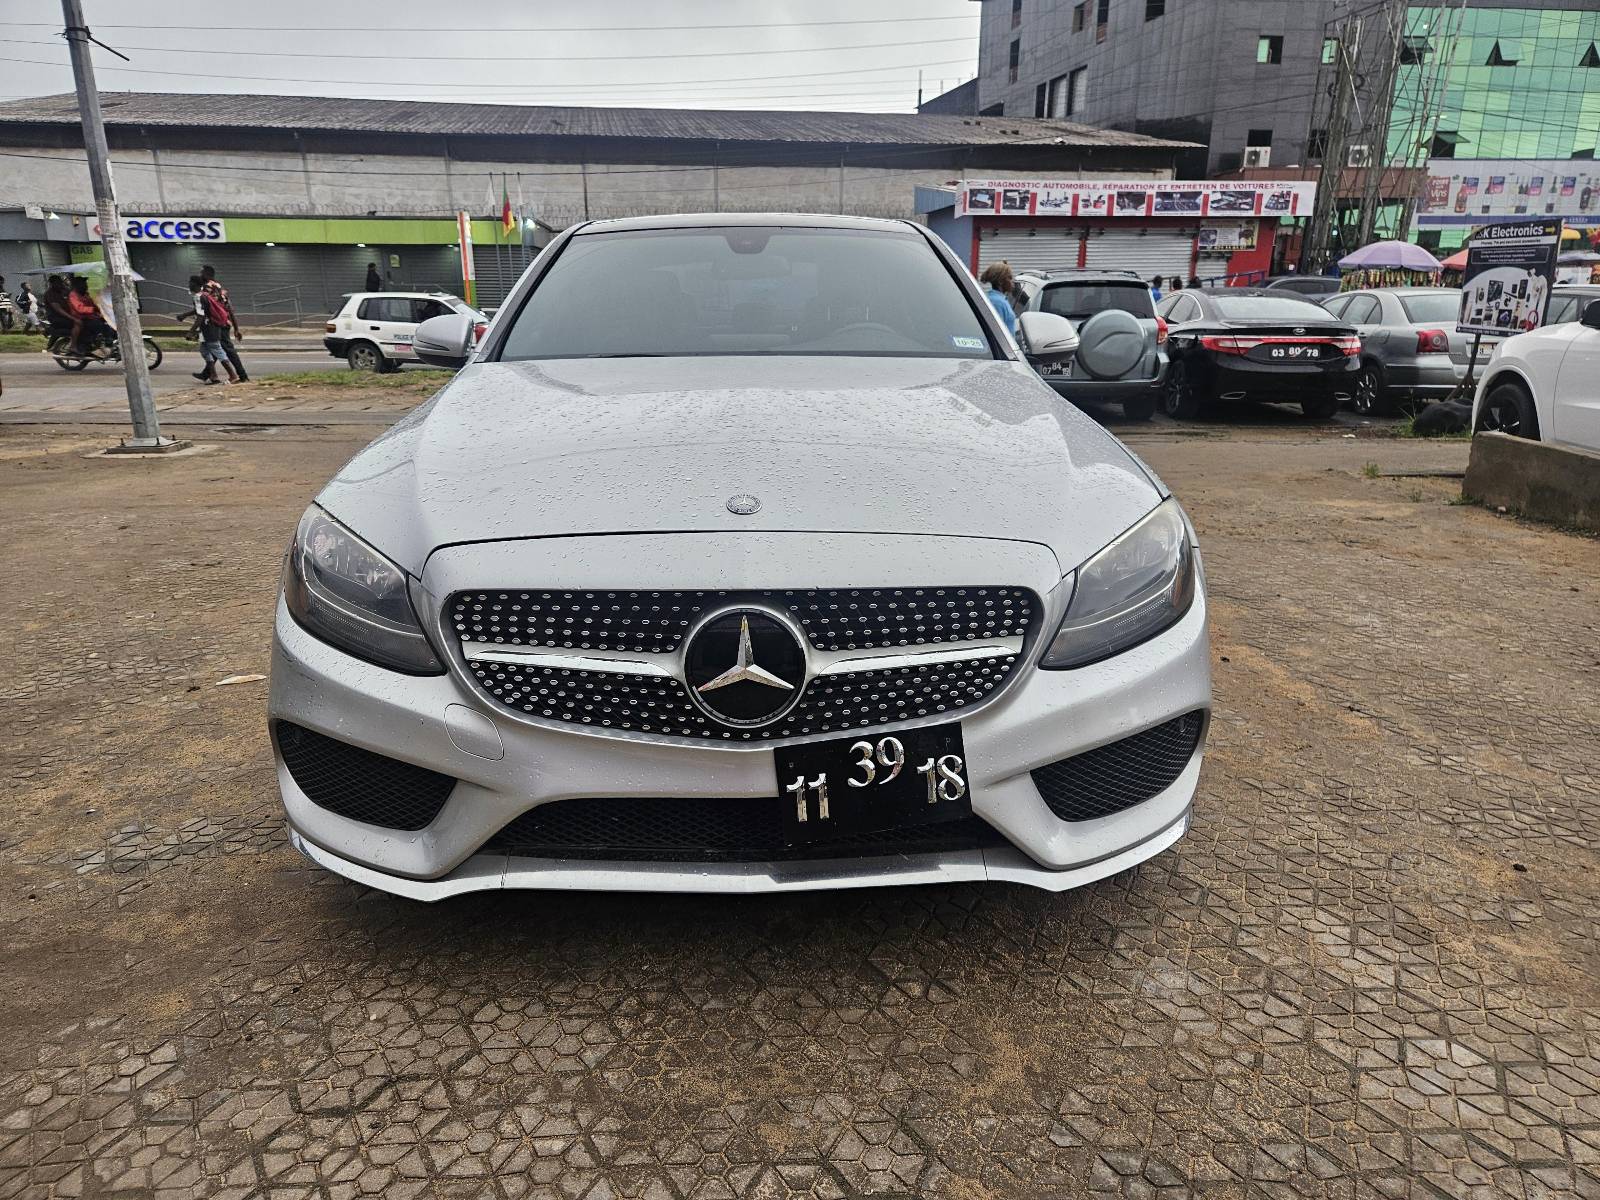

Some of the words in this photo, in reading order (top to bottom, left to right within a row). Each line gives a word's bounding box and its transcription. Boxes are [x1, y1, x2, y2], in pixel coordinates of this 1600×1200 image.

[1043, 182, 1100, 190] AUTOMOBILE,
[1102, 182, 1154, 190] RÉPARATION
[126, 220, 221, 240] access
[1491, 223, 1544, 238] Electronics
[72, 246, 93, 255] GAB
[1272, 348, 1285, 357] 03
[1288, 346, 1301, 355] 80
[1306, 348, 1319, 357] 78
[1042, 366, 1052, 375] 07
[1051, 362, 1062, 371] 84
[786, 772, 830, 823] 11
[847, 736, 905, 788] 39
[916, 754, 966, 804] 18
